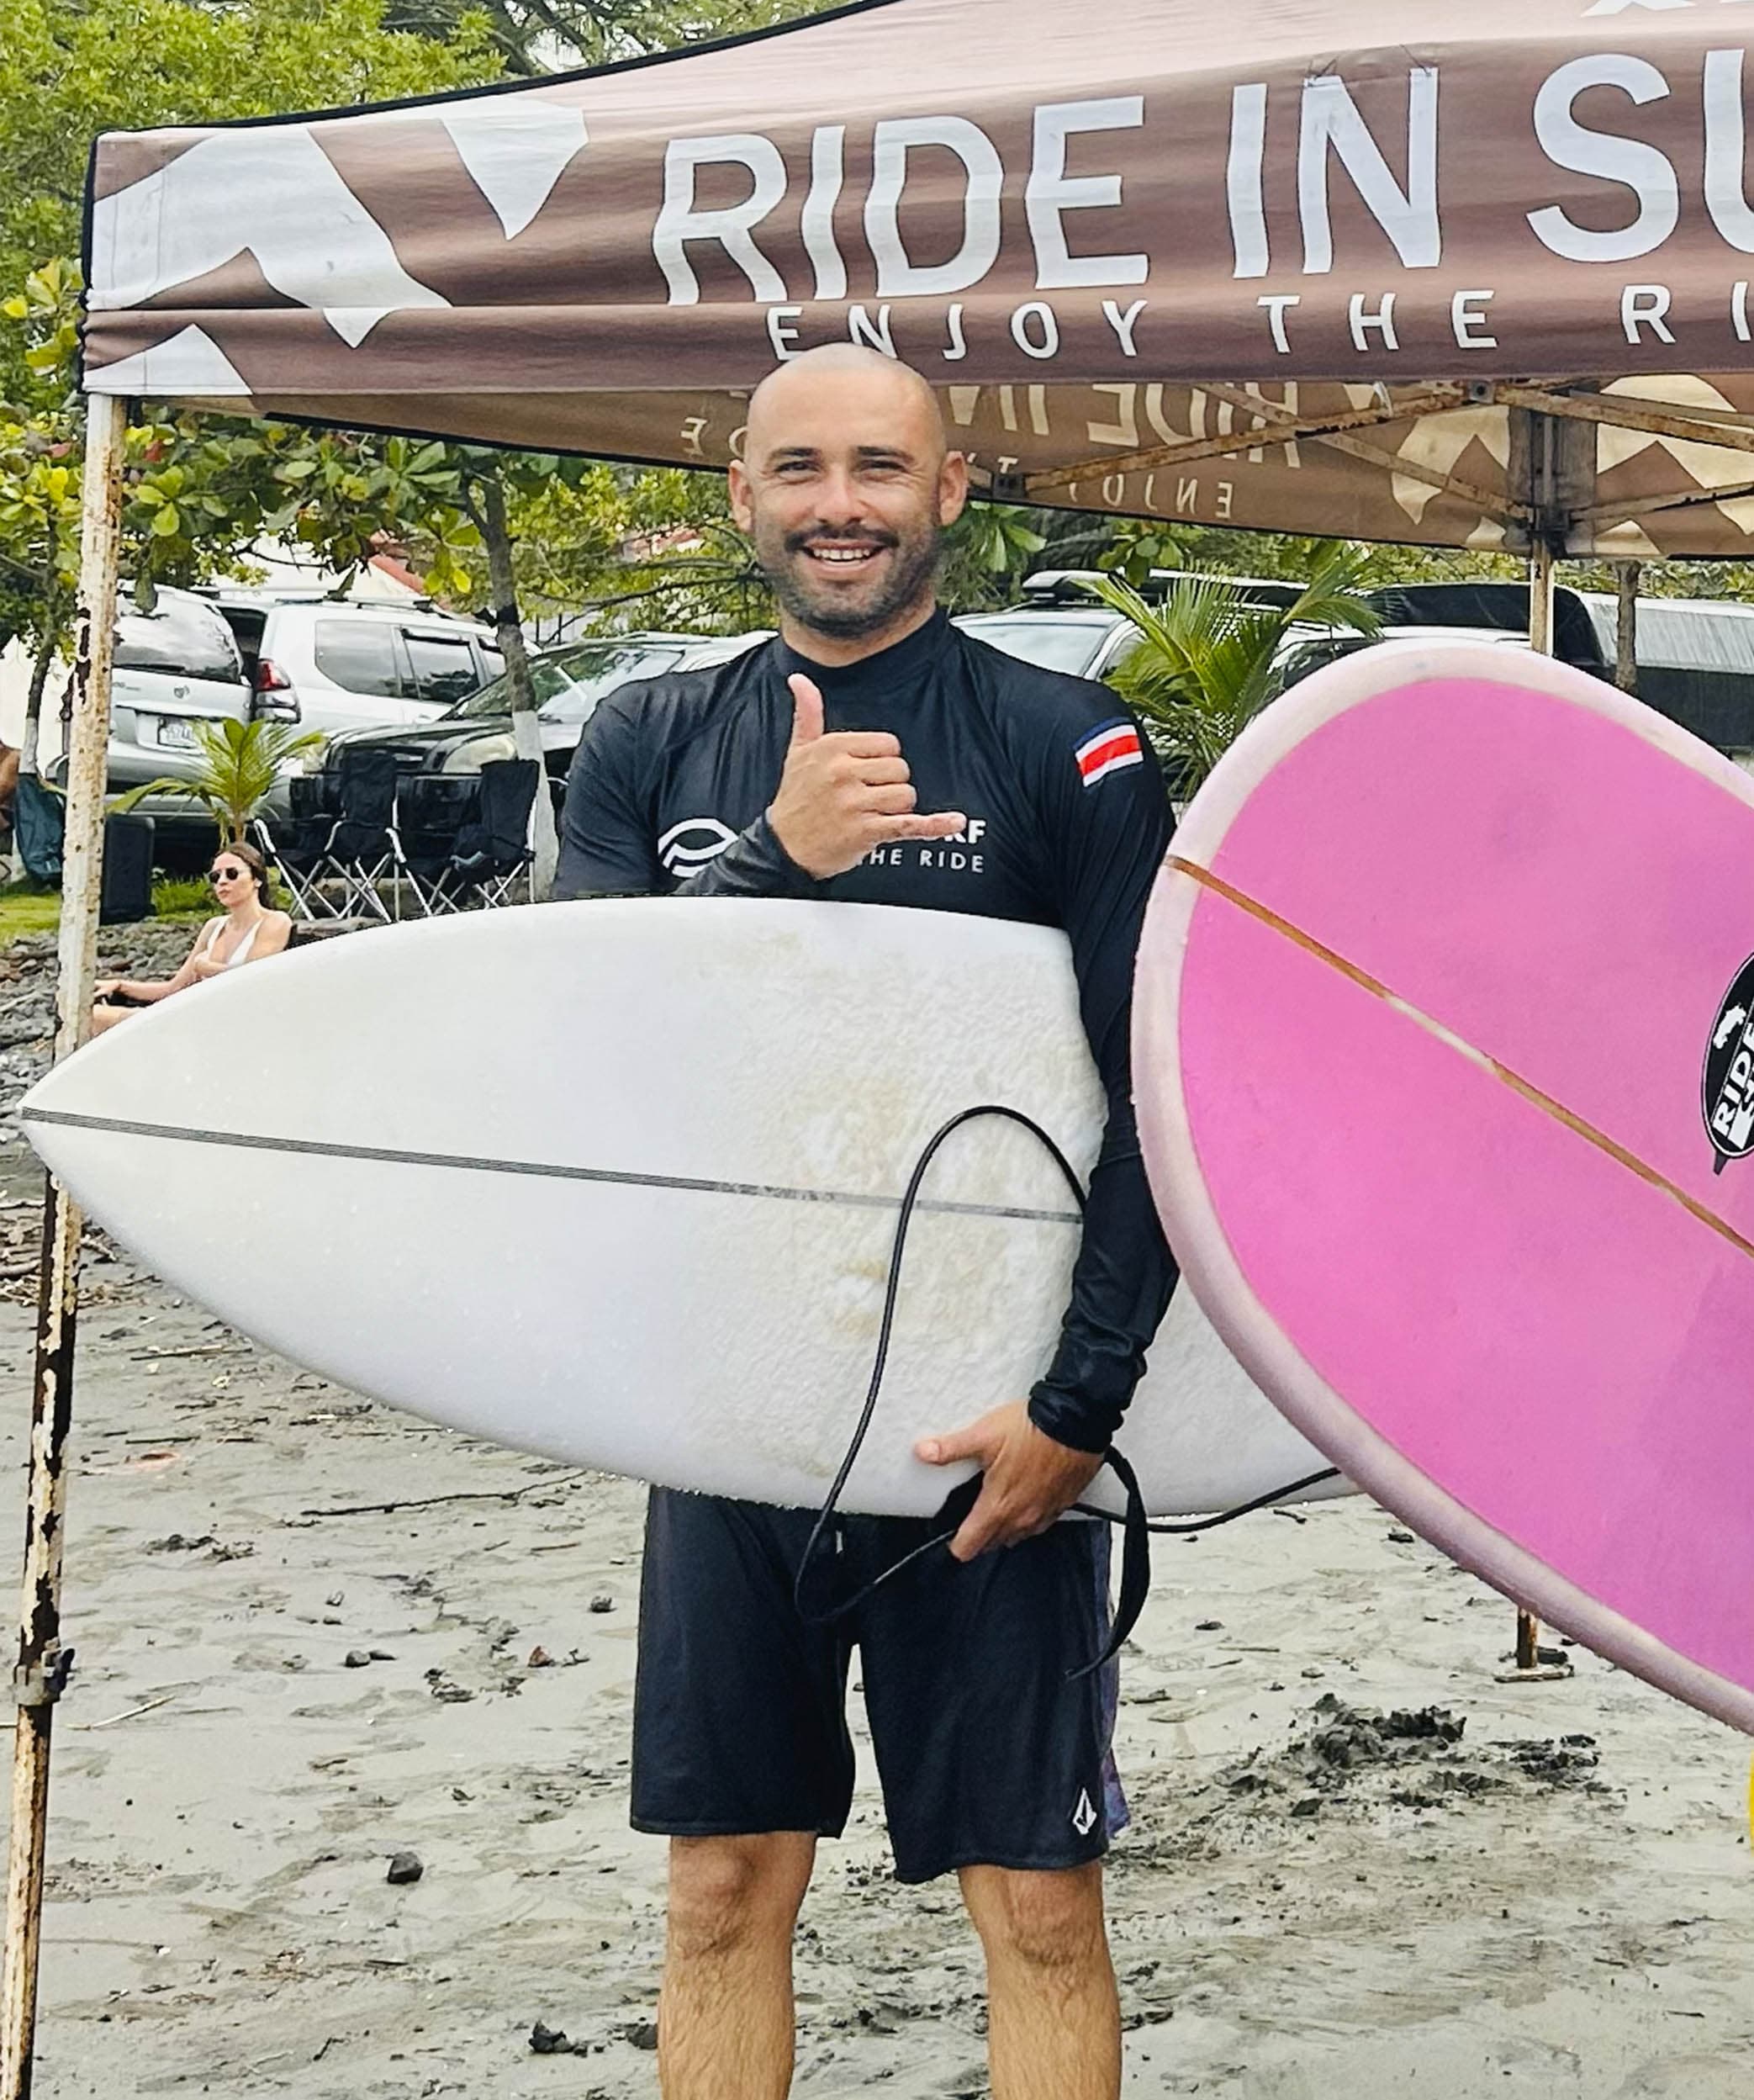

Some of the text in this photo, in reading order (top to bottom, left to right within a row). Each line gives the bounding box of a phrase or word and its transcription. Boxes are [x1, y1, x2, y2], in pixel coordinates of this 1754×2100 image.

[652, 95, 1149, 305] RIDE
[1227, 67, 1442, 278] IN
[766, 299, 1148, 360] ENJOY
[1257, 289, 1498, 353] THE
[861, 848, 984, 873] HE RIDE
